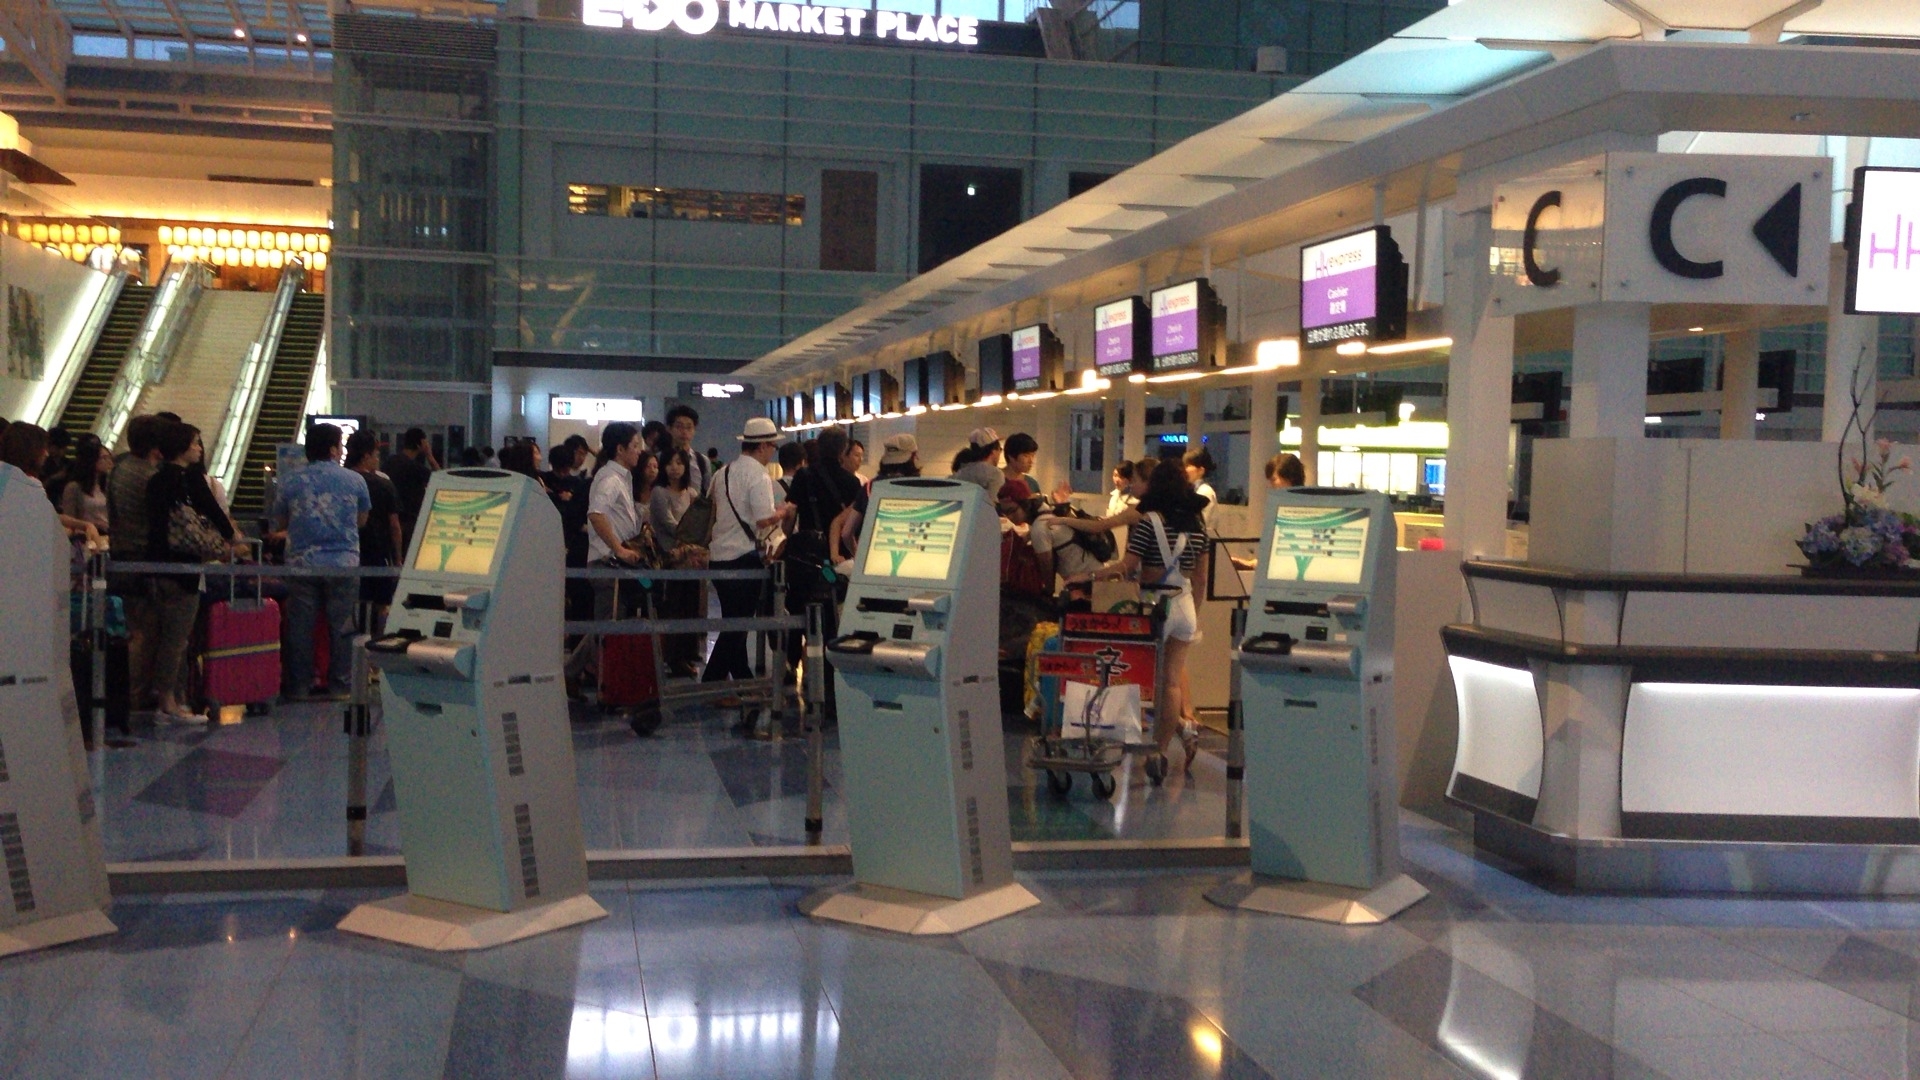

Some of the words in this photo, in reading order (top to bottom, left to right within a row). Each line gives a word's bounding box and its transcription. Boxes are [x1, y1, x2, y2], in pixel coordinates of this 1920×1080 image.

[728, 0, 866, 37] MARKET
[876, 12, 979, 45] PLACE
[1522, 189, 1562, 288] C
[1648, 176, 1727, 280] C
